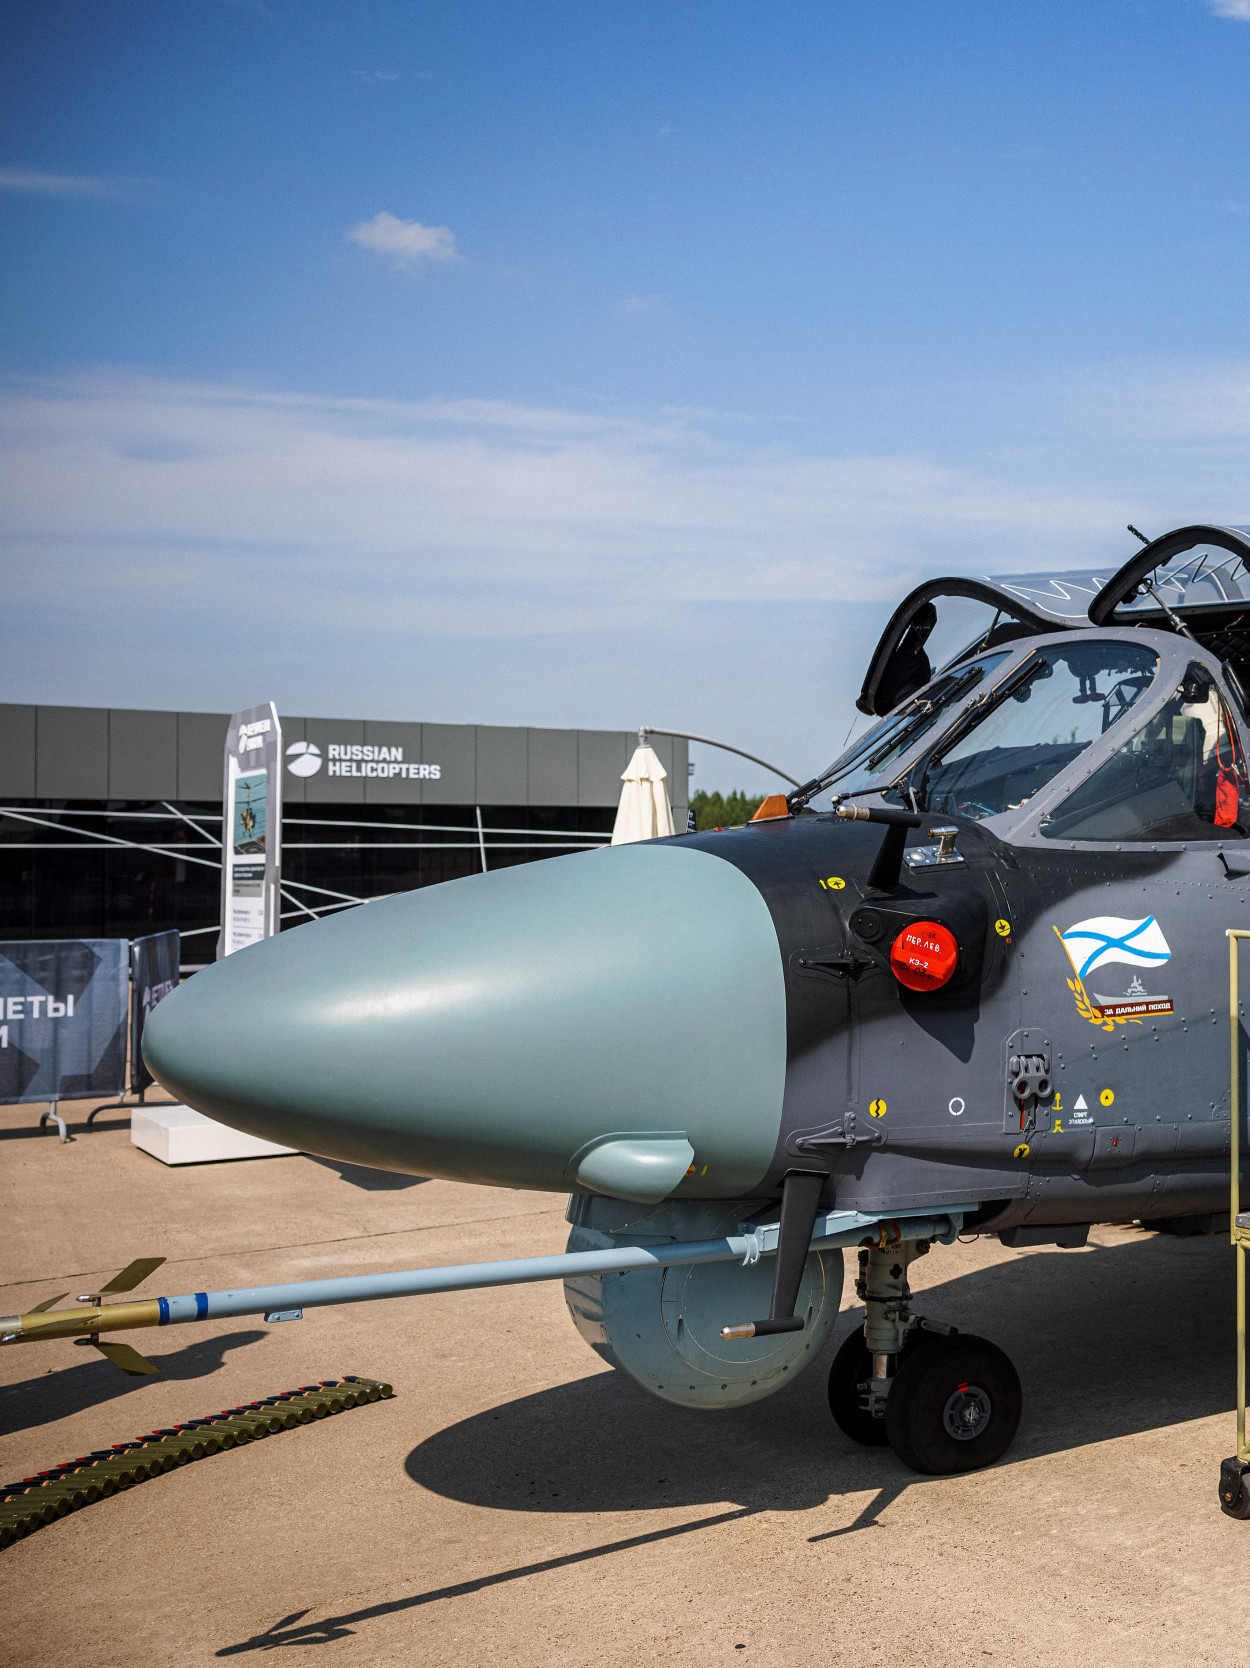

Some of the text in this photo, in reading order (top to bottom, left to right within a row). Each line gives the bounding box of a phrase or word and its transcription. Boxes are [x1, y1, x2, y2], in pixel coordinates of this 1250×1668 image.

[328, 744, 403, 762] RUSSIAN
[328, 761, 441, 779] HELICOPTERS
[0, 994, 75, 1020] ЕТЫ
[1104, 1002, 1171, 1016] ЗА ДАЛЬНИЙ ПОХОД
